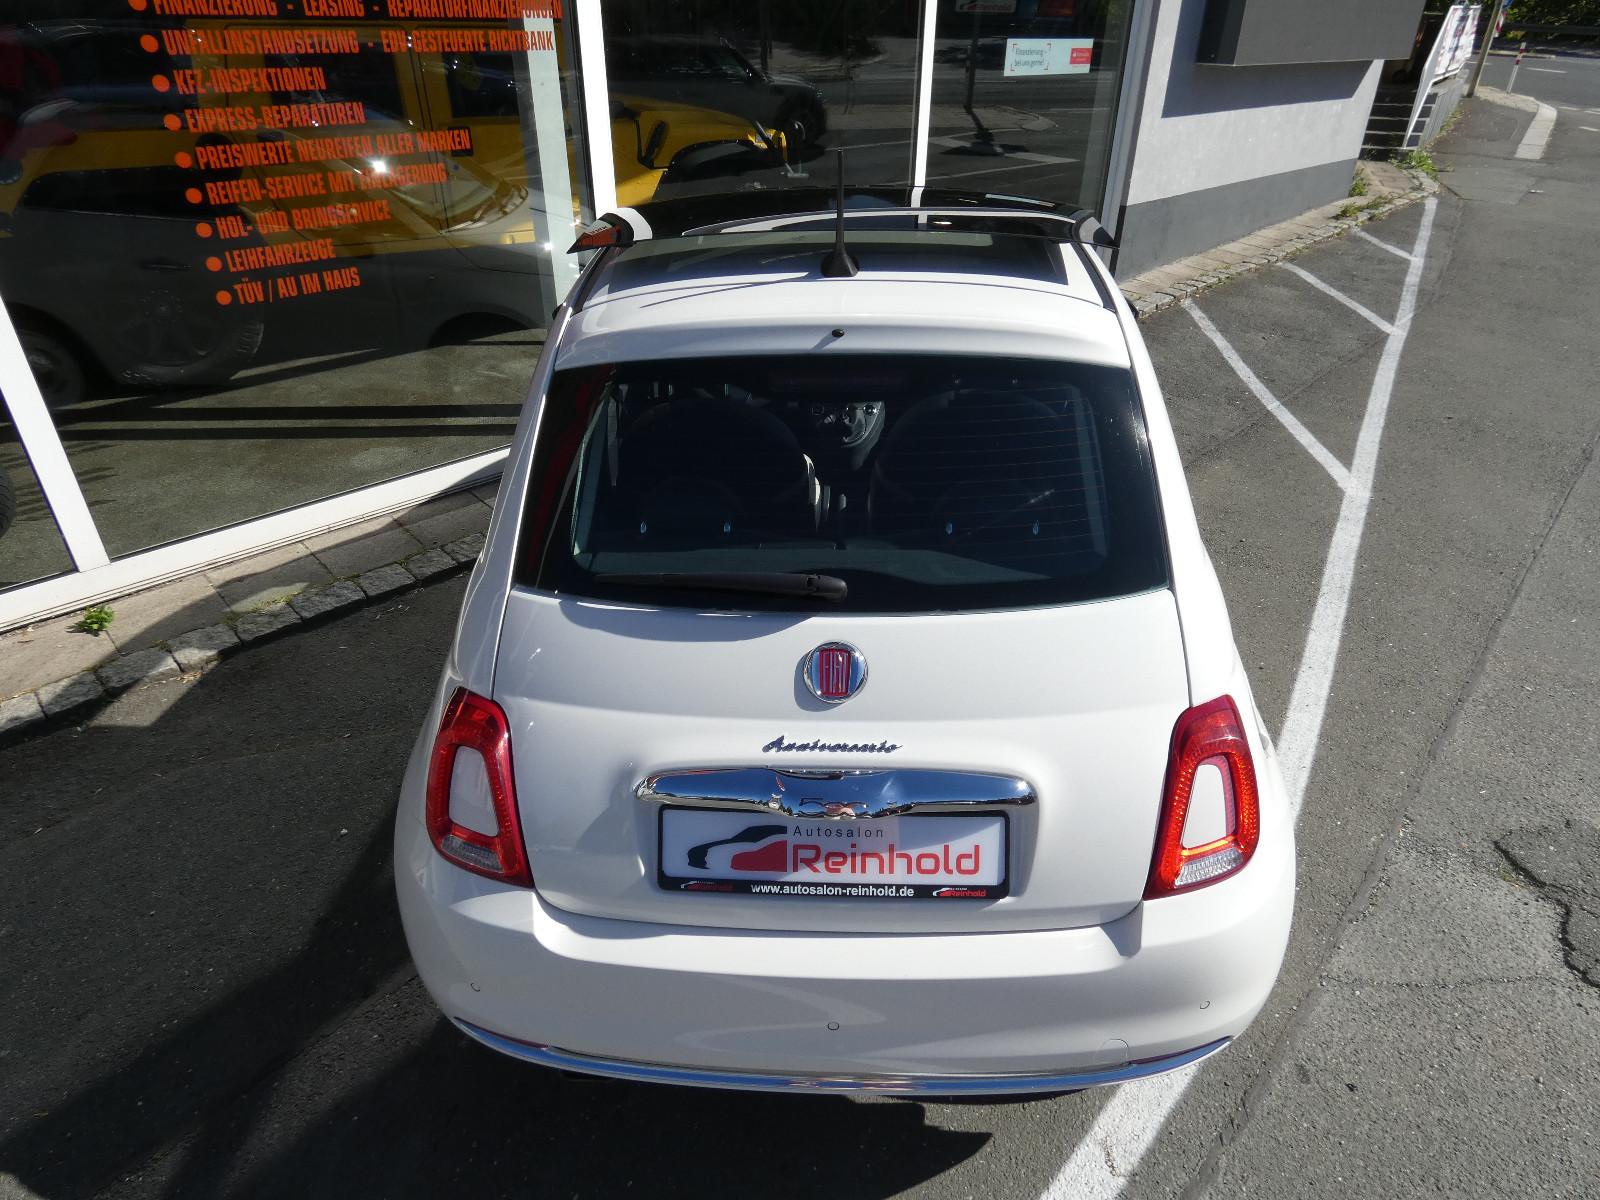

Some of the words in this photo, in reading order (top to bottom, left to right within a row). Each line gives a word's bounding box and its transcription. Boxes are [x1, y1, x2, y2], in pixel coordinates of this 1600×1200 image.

[153, 0, 278, 16] FINANZIERUNG
[303, 0, 365, 17] LEASING
[161, 28, 360, 55] UNFALLINSTANDSETZUNG
[489, 30, 555, 52] RICHTBANK
[173, 67, 326, 95] KFZ-INSPEKTIONEN
[184, 102, 366, 133] EXPRESS-REPARATUREN
[195, 140, 295, 170] PREISWERTE
[296, 135, 374, 162] NEUREIFEN
[375, 132, 415, 157] ALLER
[415, 129, 472, 153] MARKEN
[205, 175, 327, 205] REIFEN-SERVICE
[327, 171, 356, 193] MIT
[359, 163, 448, 191] EINLAGERUNG
[215, 215, 253, 239] HOL-
[255, 211, 290, 235] UND
[291, 200, 391, 230] BRINGSERVICE
[225, 238, 336, 272] LEIHFAHRZEUGE
[234, 277, 265, 304] TÜV
[277, 275, 299, 299] AU
[300, 272, 321, 294] IM
[323, 267, 361, 291] HAUS
[823, 651, 848, 694] FIAT
[793, 825, 884, 838] Autosalon
[792, 843, 980, 875] Reinhold
[751, 883, 915, 897] www.autosalon-reinhold.de
